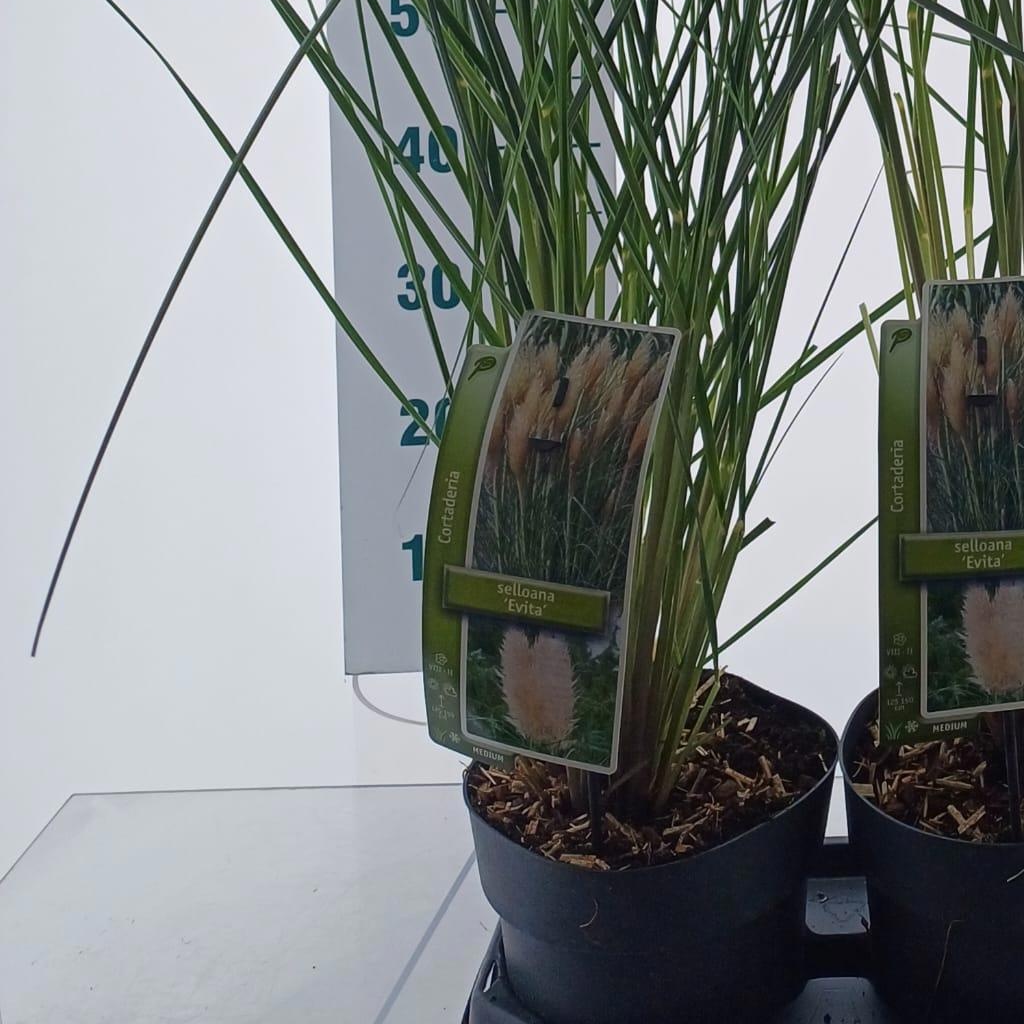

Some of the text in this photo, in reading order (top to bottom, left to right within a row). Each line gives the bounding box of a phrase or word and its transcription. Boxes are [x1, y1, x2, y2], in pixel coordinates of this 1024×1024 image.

[394, 125, 458, 173] 40
[397, 263, 461, 311] 30
[890, 439, 904, 513] Cortaderia
[438, 470, 460, 544] Cortaderia
[954, 539, 1012, 554] selloana
[497, 582, 555, 603] selloana
[932, 720, 968, 733] MEDIUM
[472, 746, 504, 762] MEDIUM
